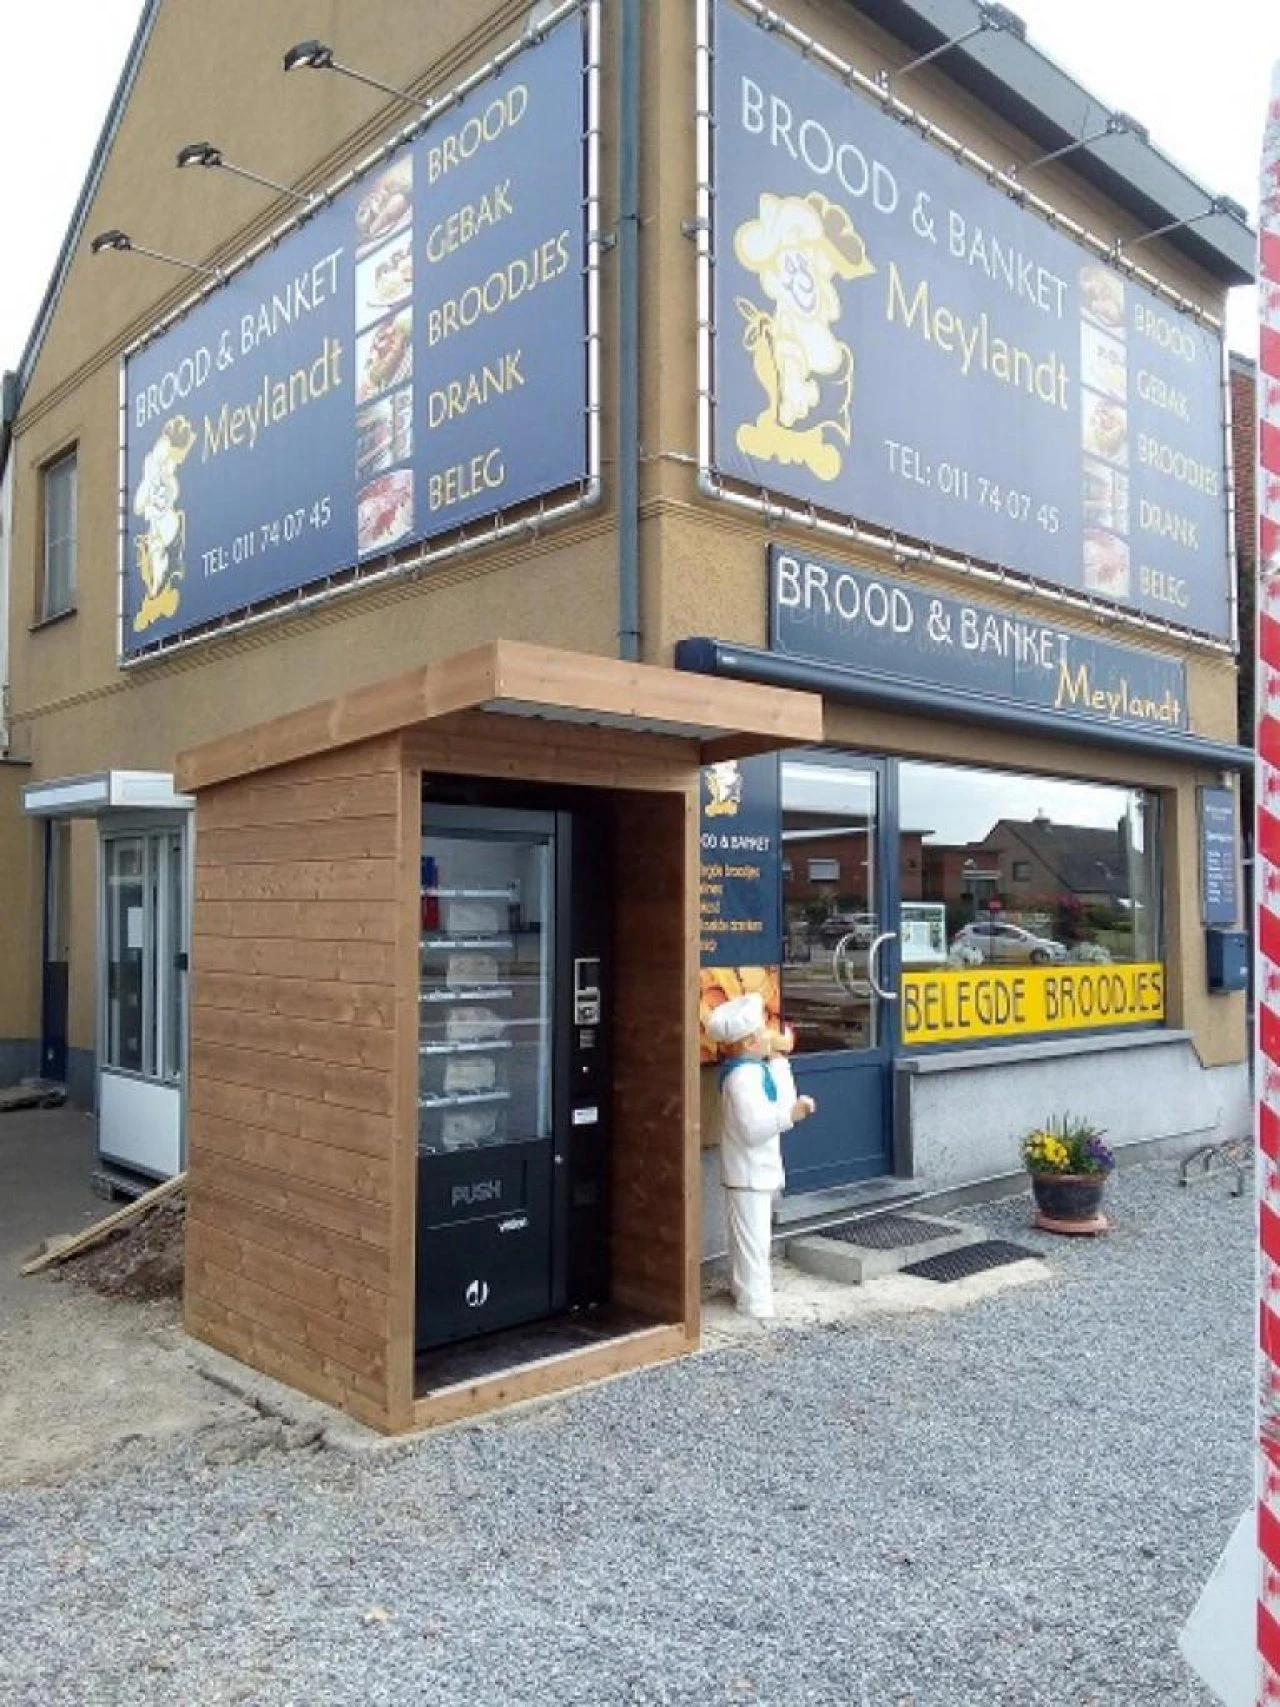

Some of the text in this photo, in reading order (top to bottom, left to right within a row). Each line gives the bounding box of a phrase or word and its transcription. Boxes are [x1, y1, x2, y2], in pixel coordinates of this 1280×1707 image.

[428, 84, 528, 184] BROOD
[426, 178, 512, 264] GEBAK
[742, 76, 1068, 319] BROOD & BANKET
[427, 230, 571, 346] BROODJES
[135, 247, 344, 428] BROOD & BANKET
[885, 261, 1069, 411] Meylandt
[1134, 304, 1196, 362] BROOD
[203, 336, 343, 463] Meylandt
[428, 350, 525, 429] DRANK
[1136, 368, 1191, 423] GEBAK
[428, 449, 506, 512] BELEG
[885, 439, 1060, 534] TEL: 011 74 07 45
[1138, 432, 1219, 497] BROODJES
[202, 496, 331, 578] TEL: 011 74 07 45
[1139, 499, 1200, 551] DRANK
[778, 556, 1071, 669] BROOD & BANKET
[1140, 565, 1189, 609] BELEG
[1054, 661, 1181, 725] Meylandt
[904, 971, 1162, 1031] BELEGDE BROODJES
[451, 1179, 501, 1208] PUSH
